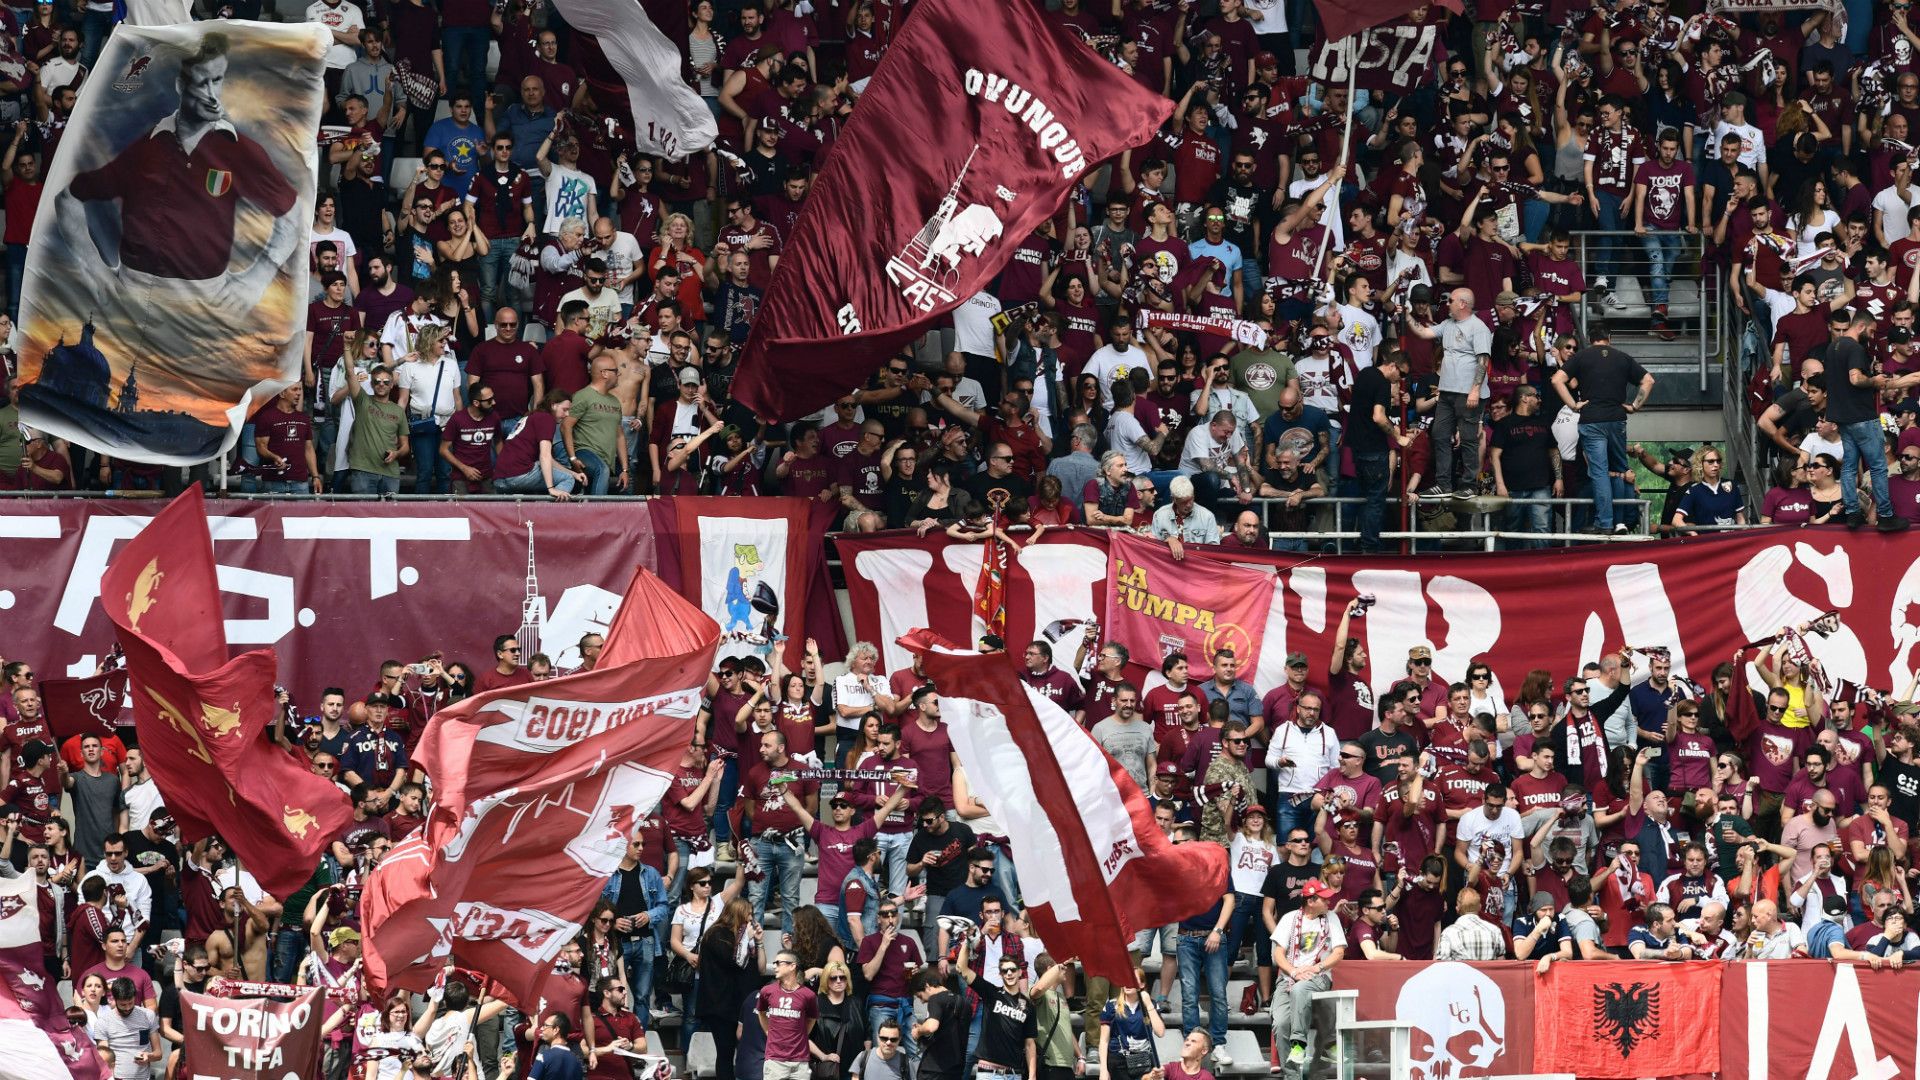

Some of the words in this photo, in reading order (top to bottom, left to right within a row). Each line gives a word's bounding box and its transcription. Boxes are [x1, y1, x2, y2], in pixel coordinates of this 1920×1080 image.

[965, 68, 1086, 180] OVUNQUE
[1648, 173, 1683, 186] TORO
[727, 235, 755, 245] TORIN
[1150, 312, 1181, 324] STADIO
[1182, 314, 1233, 330] FILADELFIA
[845, 769, 892, 781] FILADELFIA
[1523, 793, 1561, 806] TORINO
[778, 997, 793, 1009] 12
[993, 1000, 1027, 1024] Beretta
[192, 1002, 312, 1040] TORINO
[223, 1046, 283, 1071] TIFA
